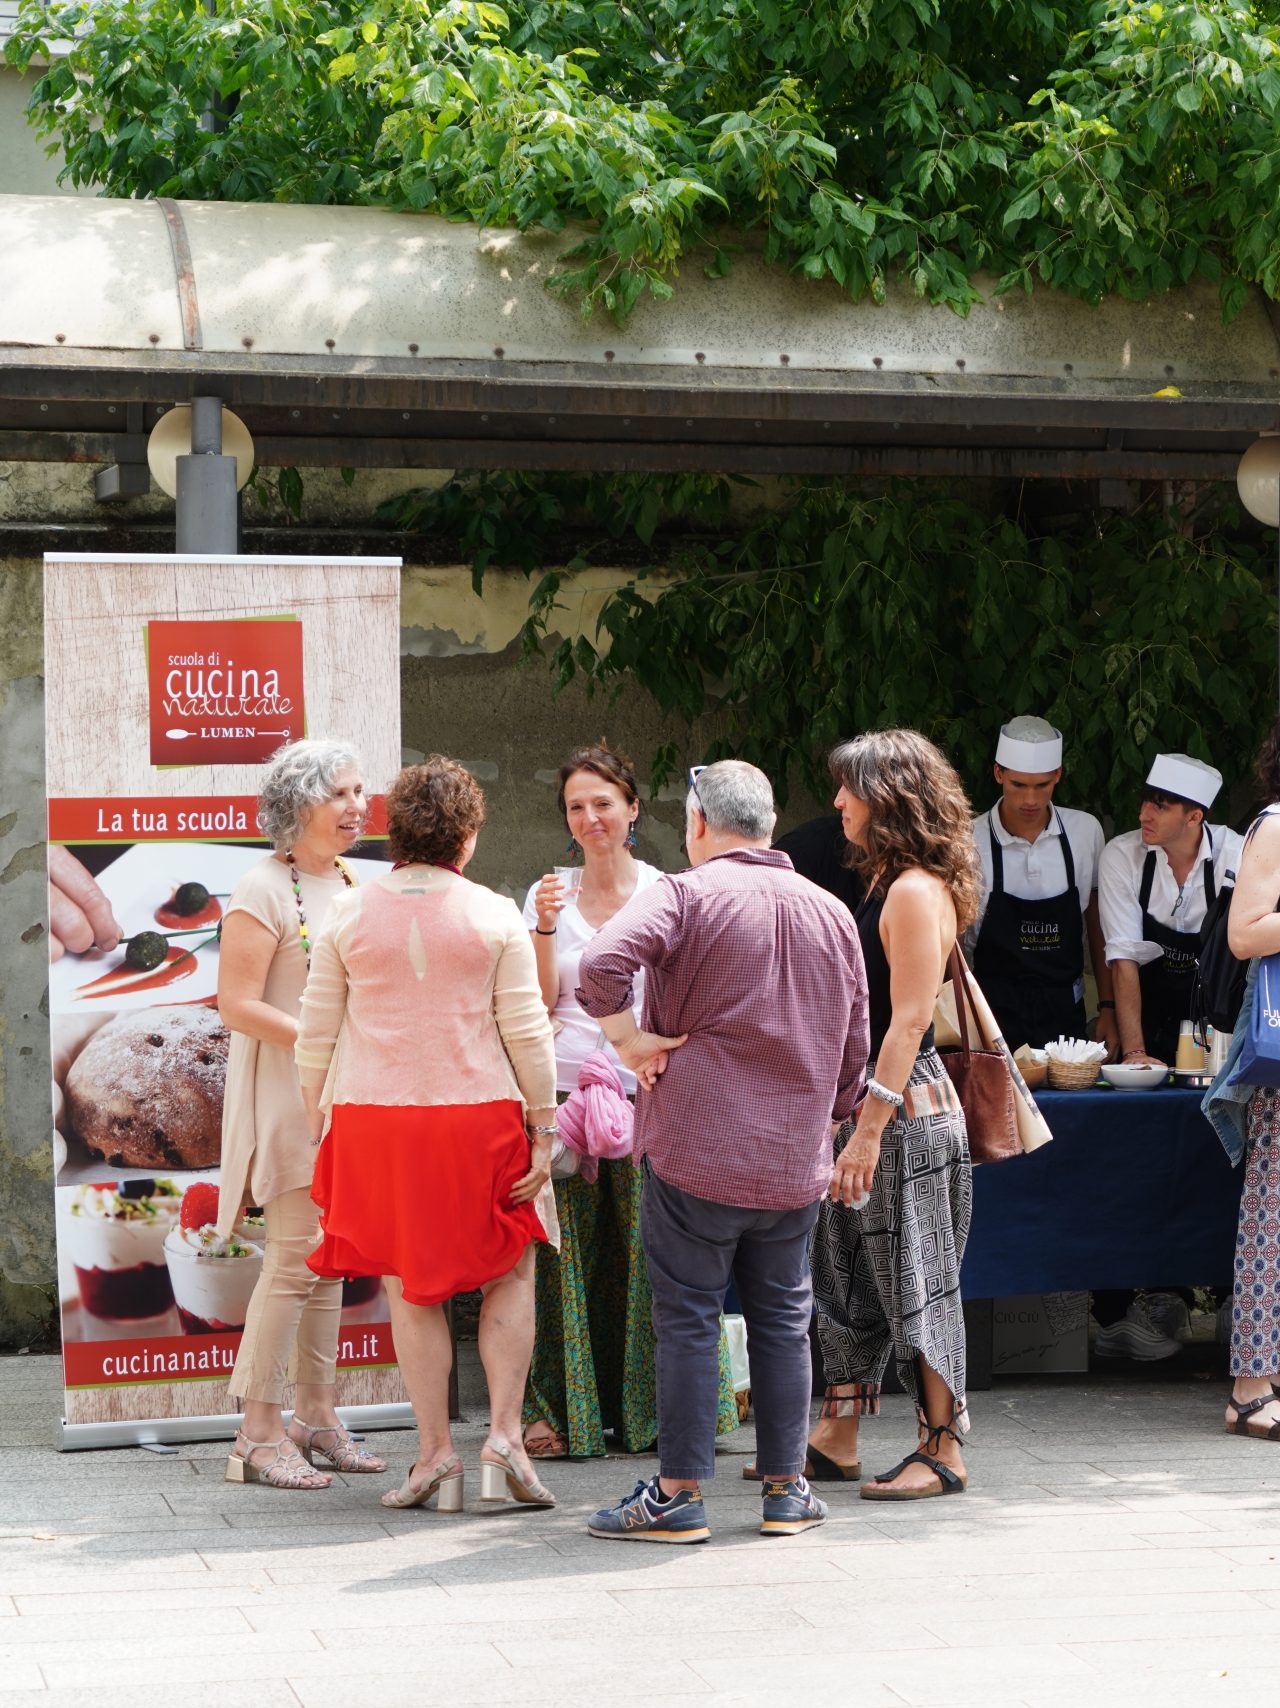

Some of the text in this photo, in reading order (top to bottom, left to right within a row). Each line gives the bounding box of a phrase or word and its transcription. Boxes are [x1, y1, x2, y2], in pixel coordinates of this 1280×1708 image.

[168, 651, 220, 666] scuola di
[166, 660, 280, 698] cucina
[162, 691, 294, 717] naturale
[200, 727, 257, 738] LUMEN
[97, 808, 123, 832] La
[132, 808, 168, 831] tua
[177, 805, 247, 831] scuola
[1020, 922, 1059, 934] cucina
